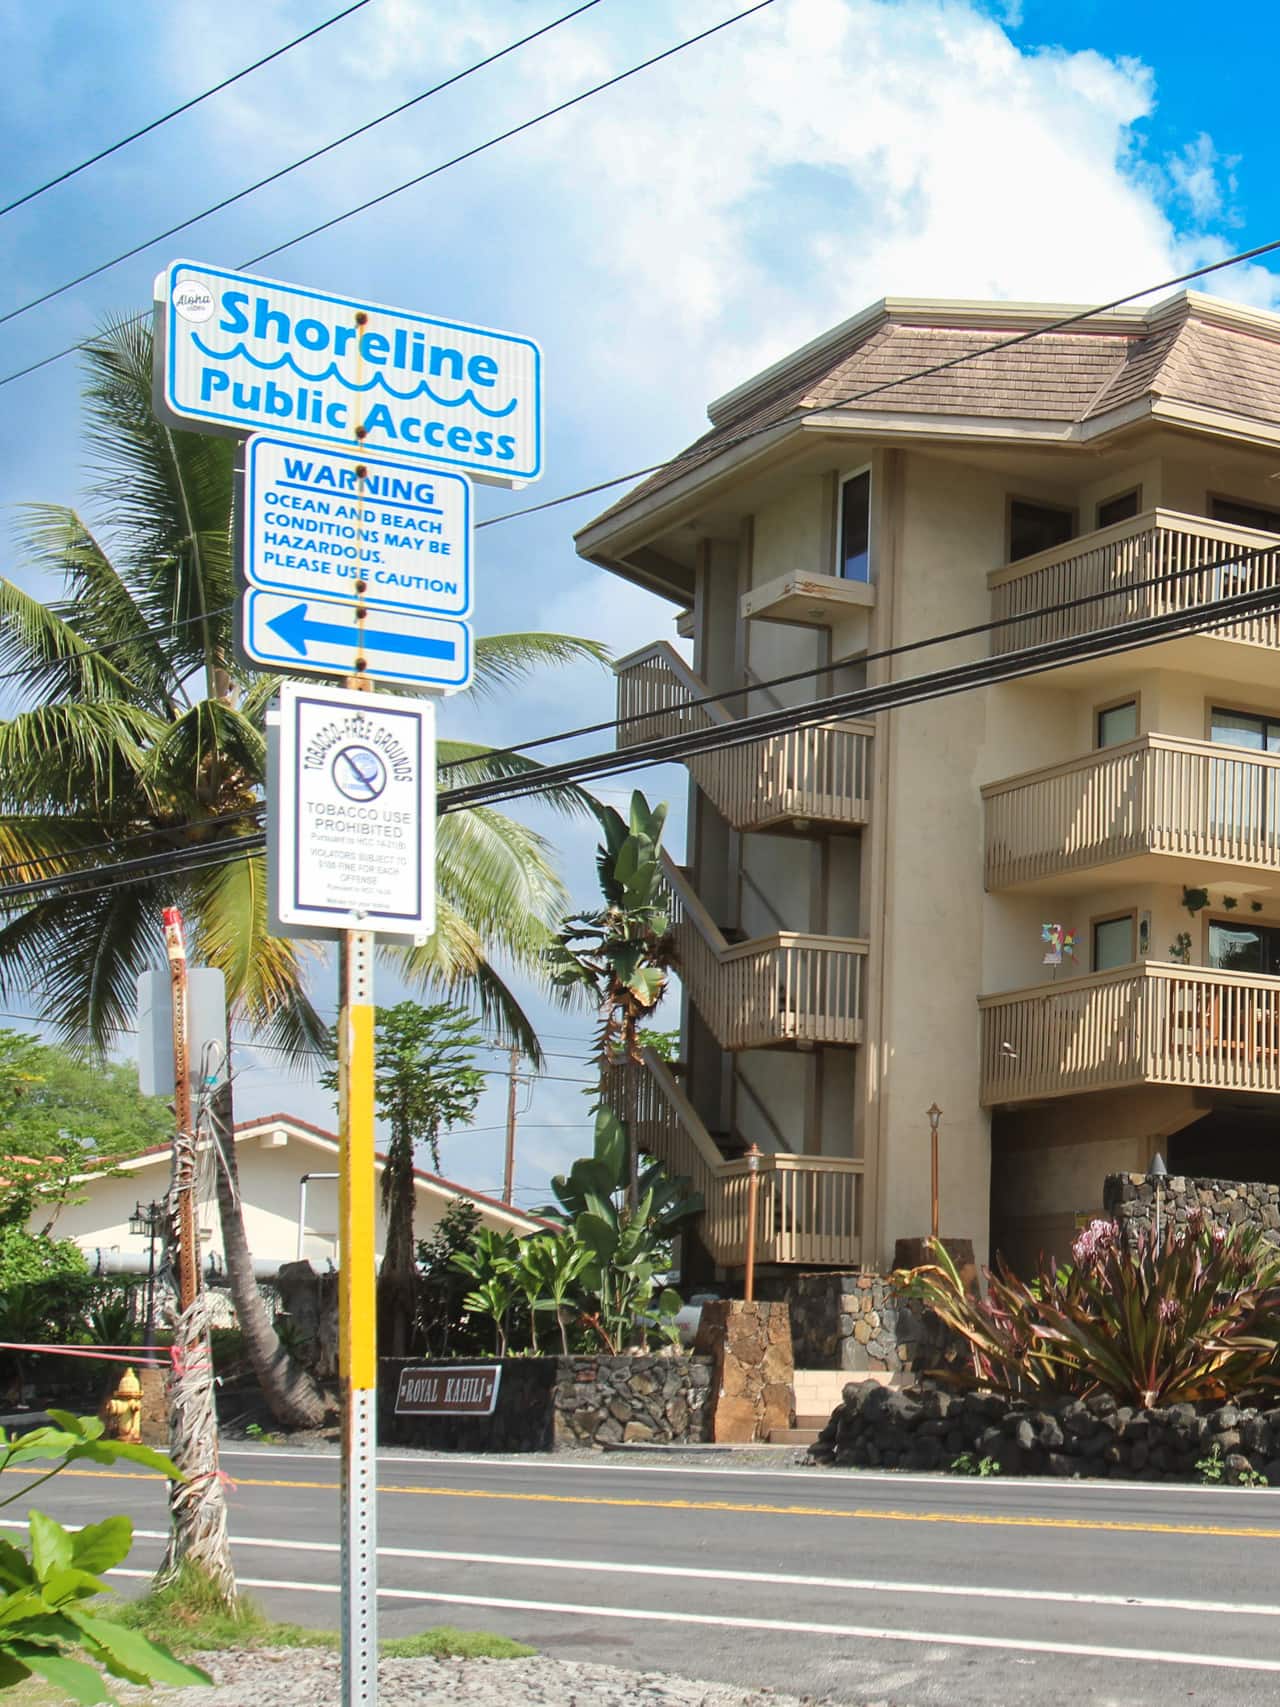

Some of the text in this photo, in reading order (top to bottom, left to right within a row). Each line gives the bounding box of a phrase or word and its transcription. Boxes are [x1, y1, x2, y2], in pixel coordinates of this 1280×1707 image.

[219, 290, 498, 387] Shoreline
[200, 367, 347, 430] Public
[361, 403, 516, 460] Access
[283, 457, 435, 505] WARNING
[264, 492, 442, 535] OCEAN AND BEACH
[264, 512, 451, 555] CONDITIONS MAY BE
[264, 532, 385, 565] HAZARDOUS.
[264, 552, 458, 595] PLEASE USE CAUTION
[306, 801, 412, 825] TOBACCO USE
[315, 818, 403, 838] PROHIBITED
[405, 1378, 486, 1402] ROYAL KAHILI
